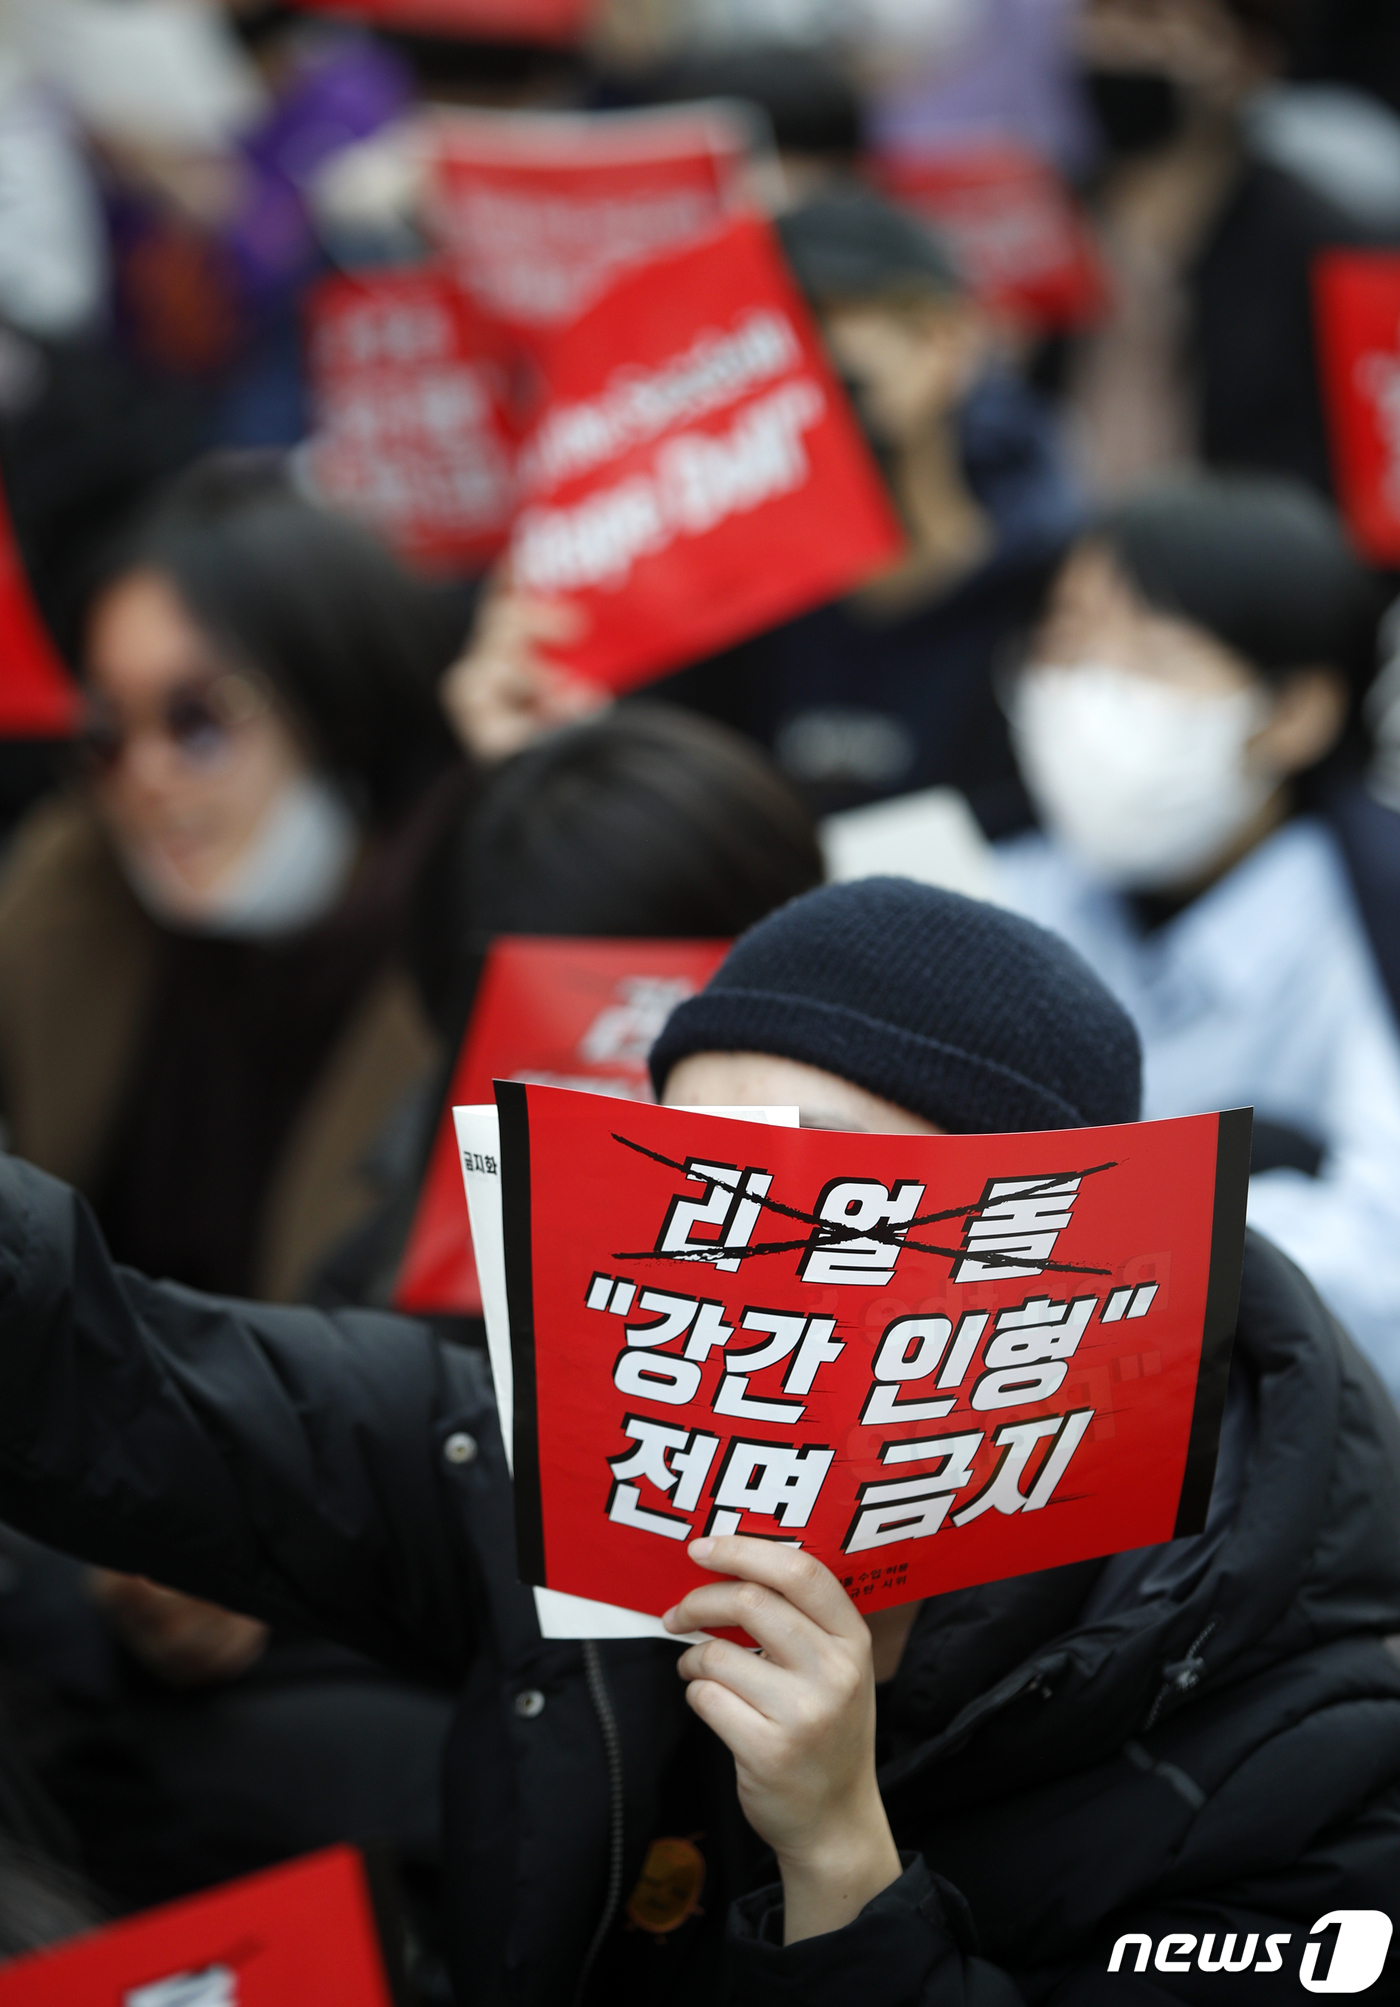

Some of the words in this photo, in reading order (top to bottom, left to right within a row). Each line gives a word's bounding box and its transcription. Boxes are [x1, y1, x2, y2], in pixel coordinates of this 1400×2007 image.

[463, 1151, 498, 1176] 금지화
[604, 1412, 837, 1549] 전면
[843, 1409, 1096, 1556] 금지
[858, 1568, 882, 1582] 수입
[881, 1575, 907, 1588] 시위
